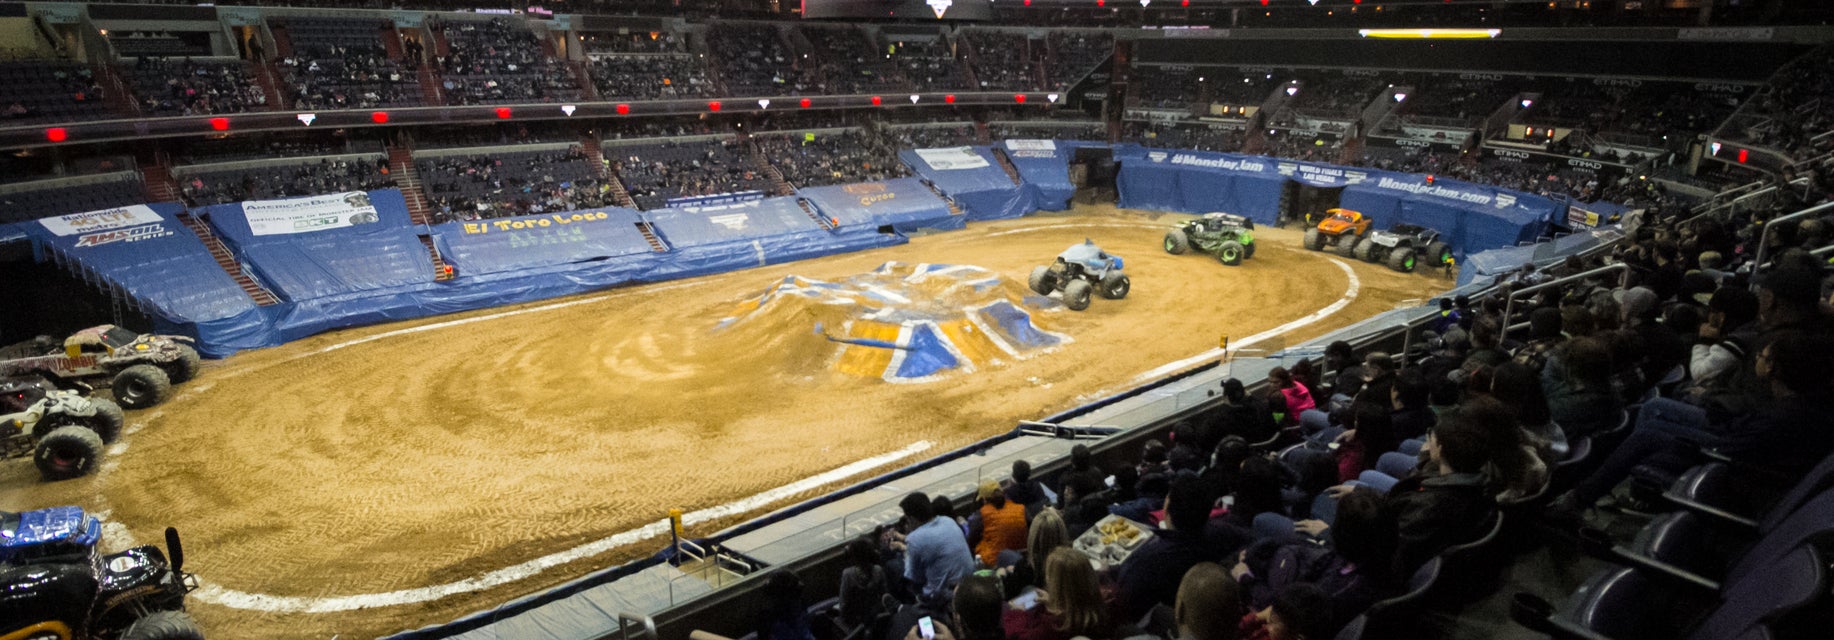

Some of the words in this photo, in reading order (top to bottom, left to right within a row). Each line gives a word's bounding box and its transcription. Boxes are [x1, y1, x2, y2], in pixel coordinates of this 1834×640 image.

[1395, 139, 1430, 147] ETIHAD
[1494, 150, 1530, 159] ETIHAD
[1568, 159, 1602, 170] ETIHAD
[1303, 172, 1315, 180] LAS
[1378, 176, 1491, 205] MonsterJam.com
[493, 218, 551, 232] Toro
[74, 223, 165, 248] AMSOIL
[125, 230, 174, 243] SERIES
